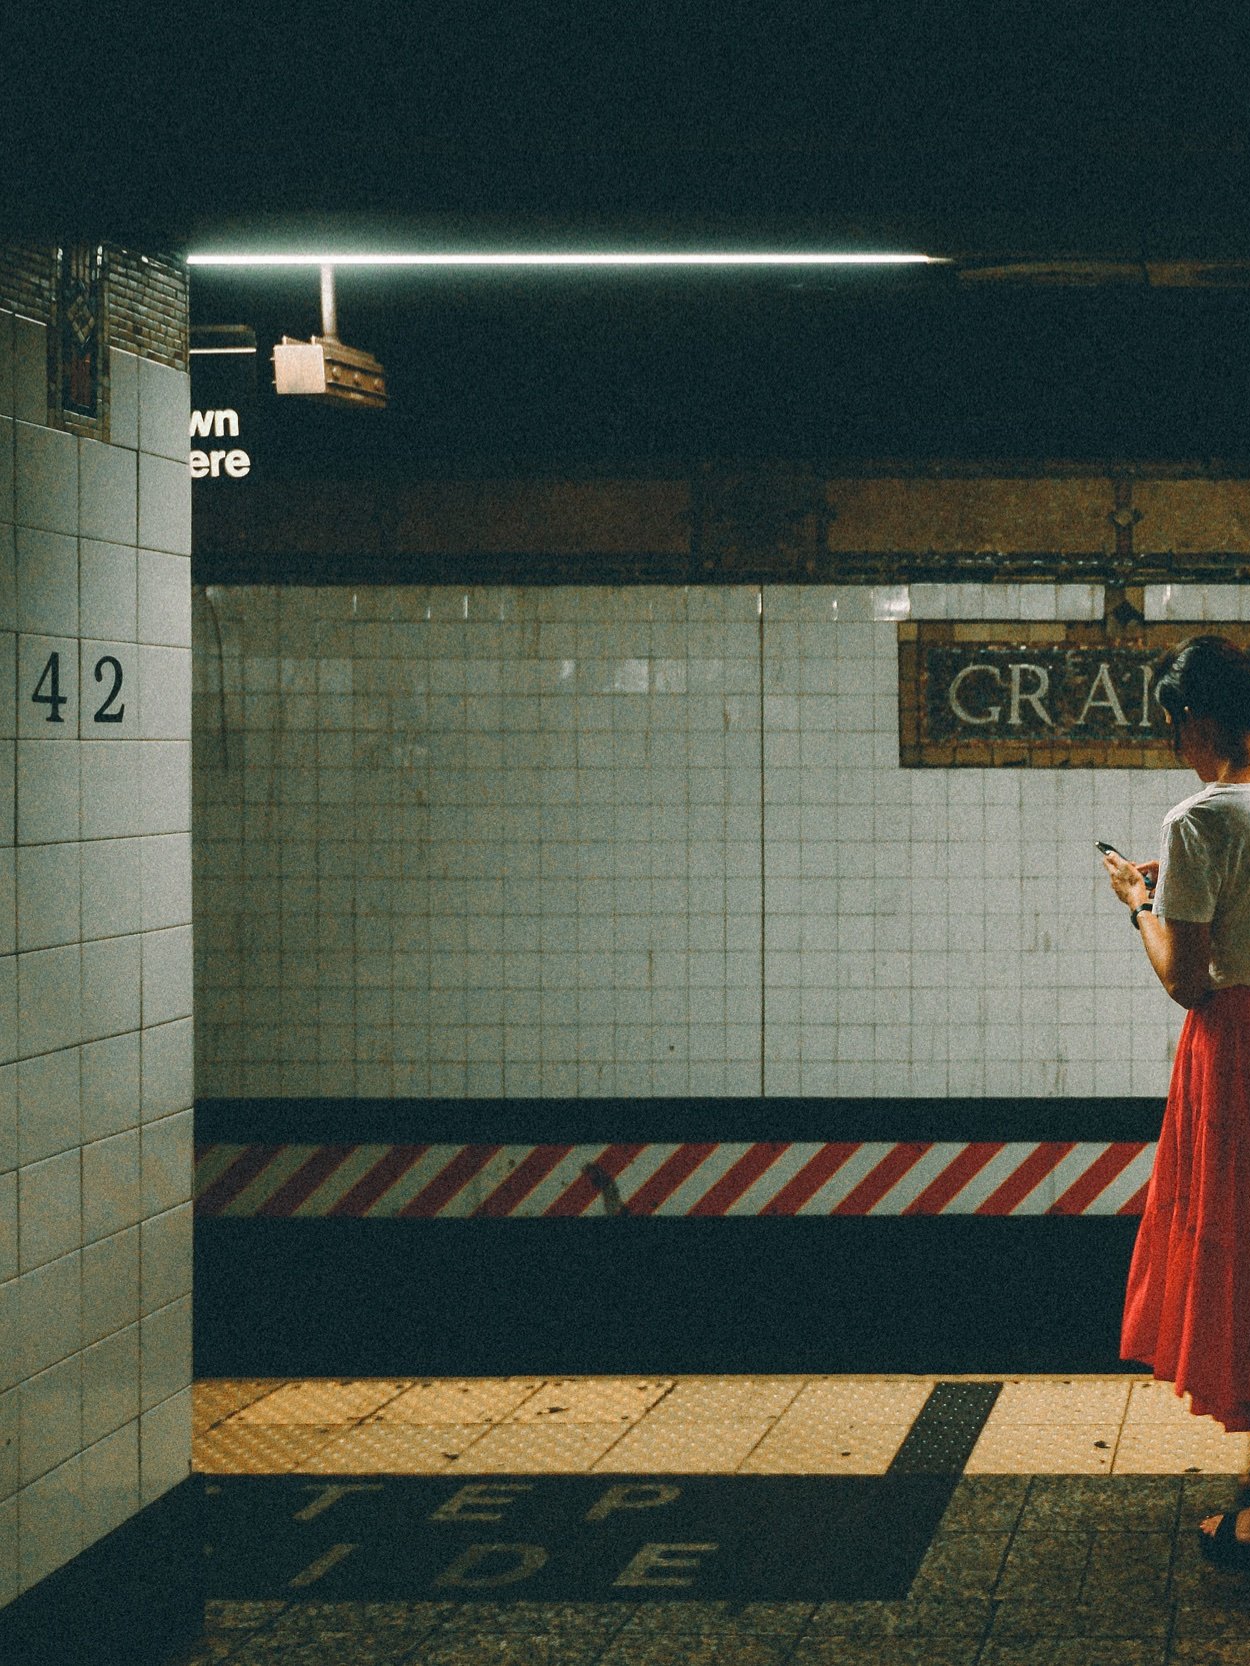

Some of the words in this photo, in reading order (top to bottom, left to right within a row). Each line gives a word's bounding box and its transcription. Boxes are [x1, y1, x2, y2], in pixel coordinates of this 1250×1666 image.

[31, 651, 126, 723] 42
[949, 662, 1153, 728] GRA
[204, 1482, 682, 1522] TEP
[204, 1542, 720, 1589] IDE
